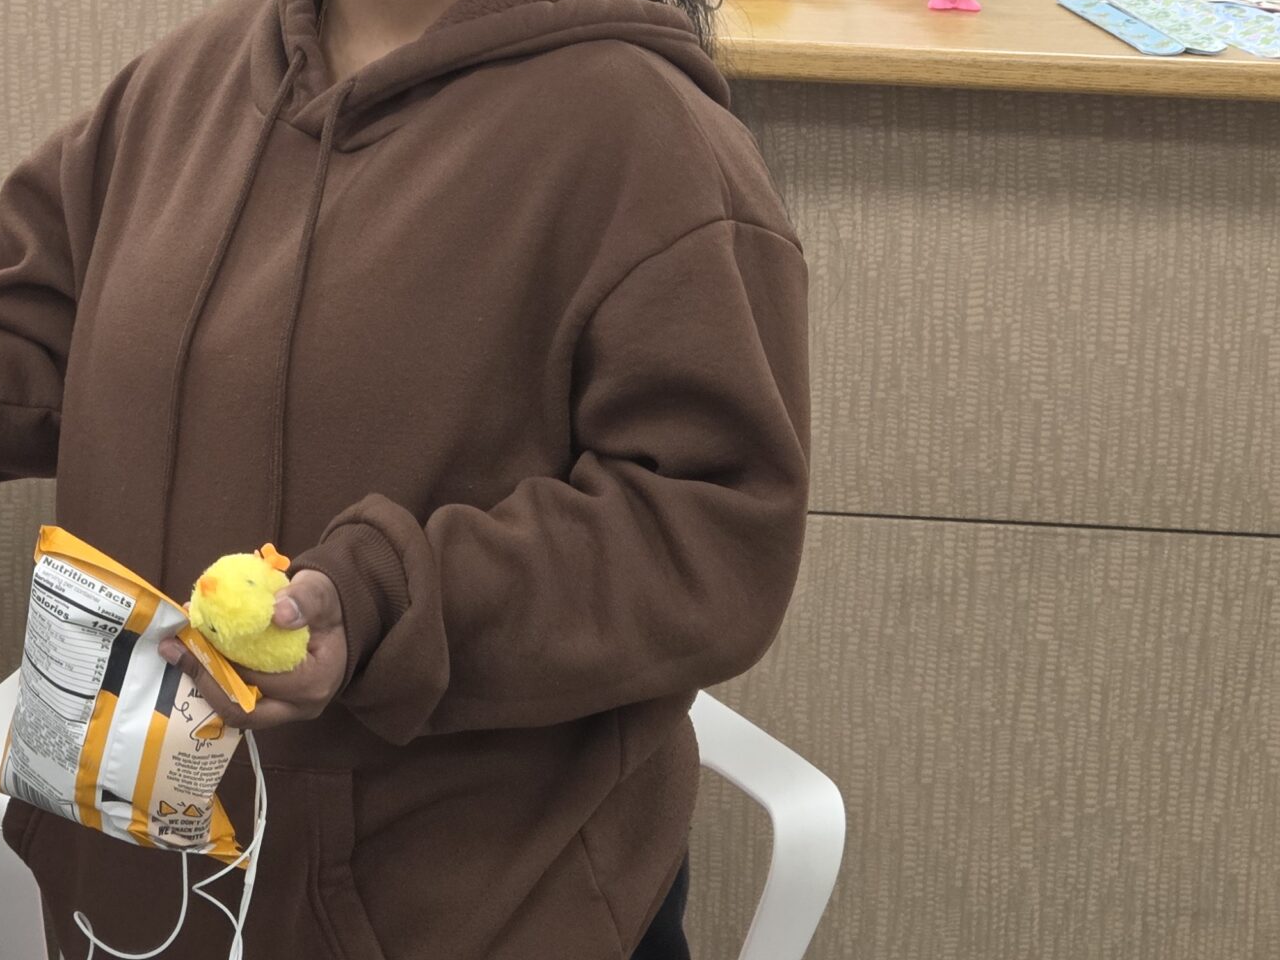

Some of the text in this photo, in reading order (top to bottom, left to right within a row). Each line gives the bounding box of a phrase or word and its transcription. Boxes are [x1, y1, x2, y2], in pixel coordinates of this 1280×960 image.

[41, 556, 132, 609] Nutrition Facts
[31, 587, 119, 635] Calories 140
